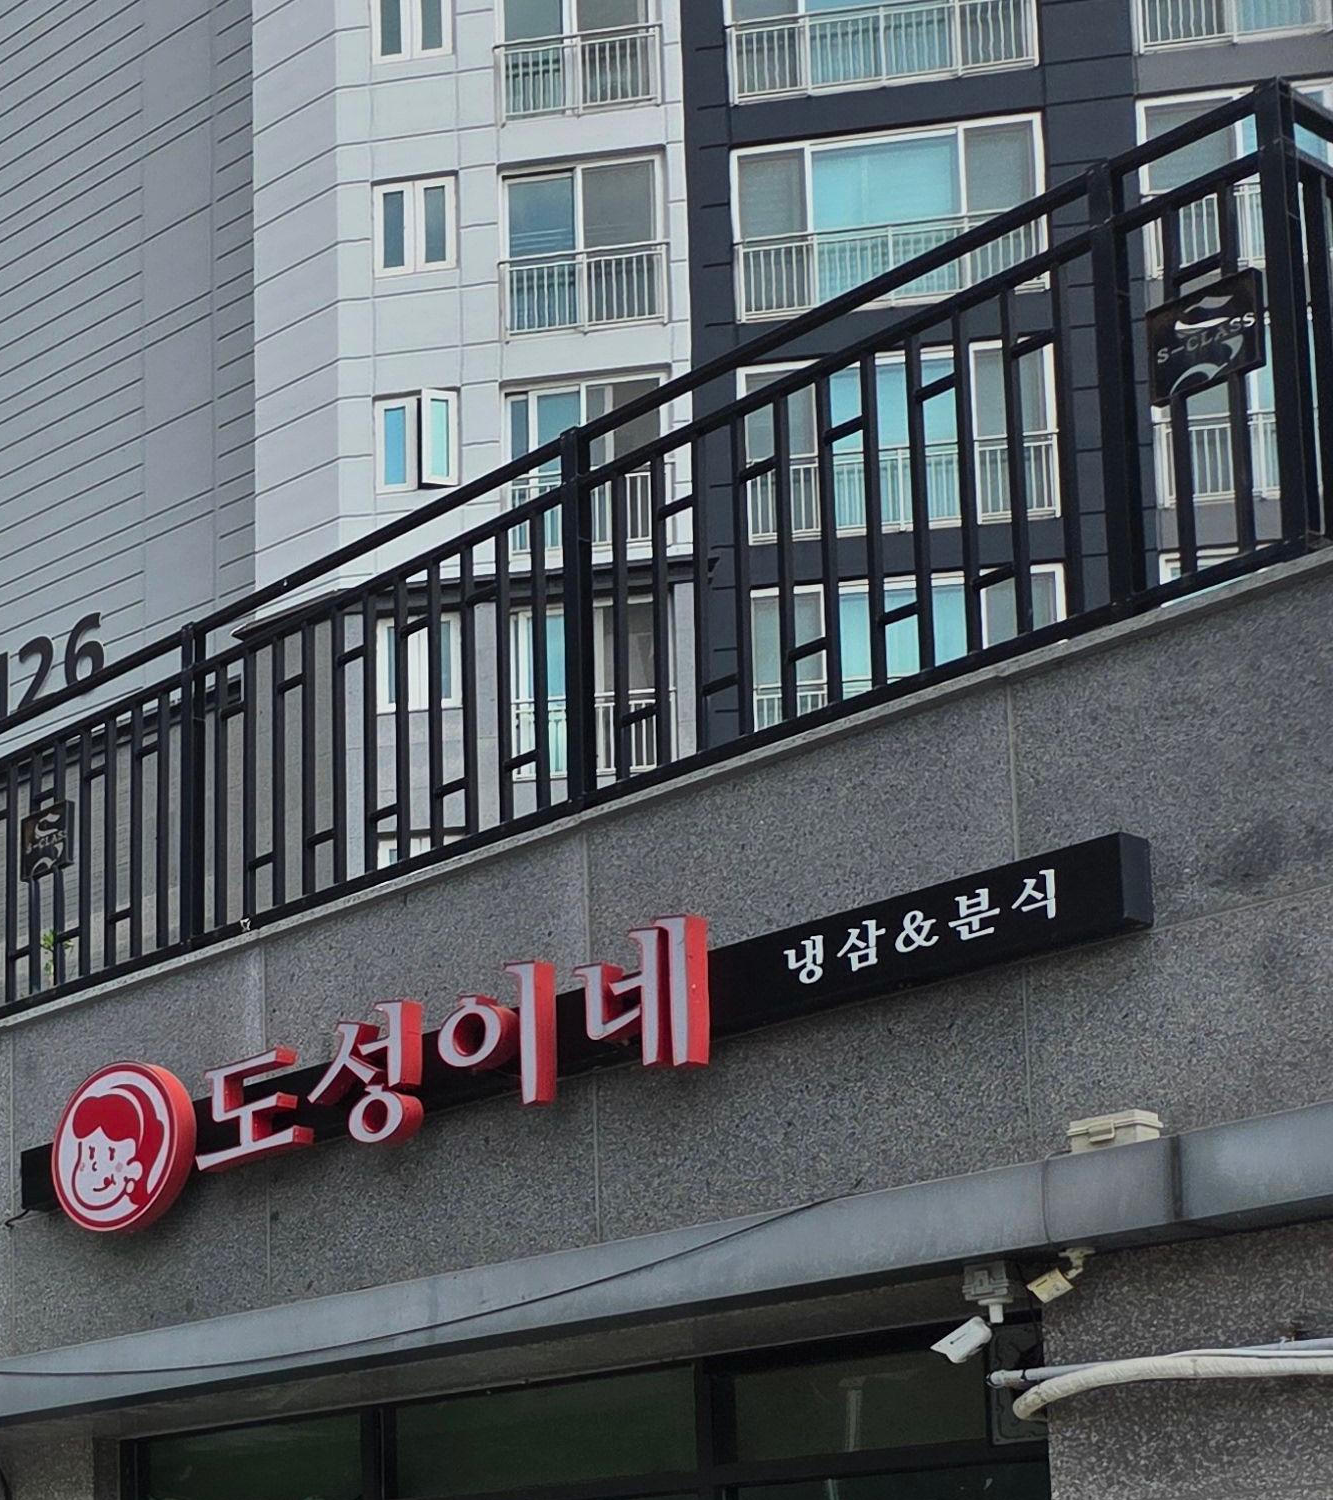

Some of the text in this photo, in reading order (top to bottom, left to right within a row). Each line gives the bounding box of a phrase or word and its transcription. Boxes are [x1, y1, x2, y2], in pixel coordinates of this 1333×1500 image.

[1156, 311, 1257, 364] S-CLASS
[195, 868, 1057, 1171] 도성이네 냉삼&분식
